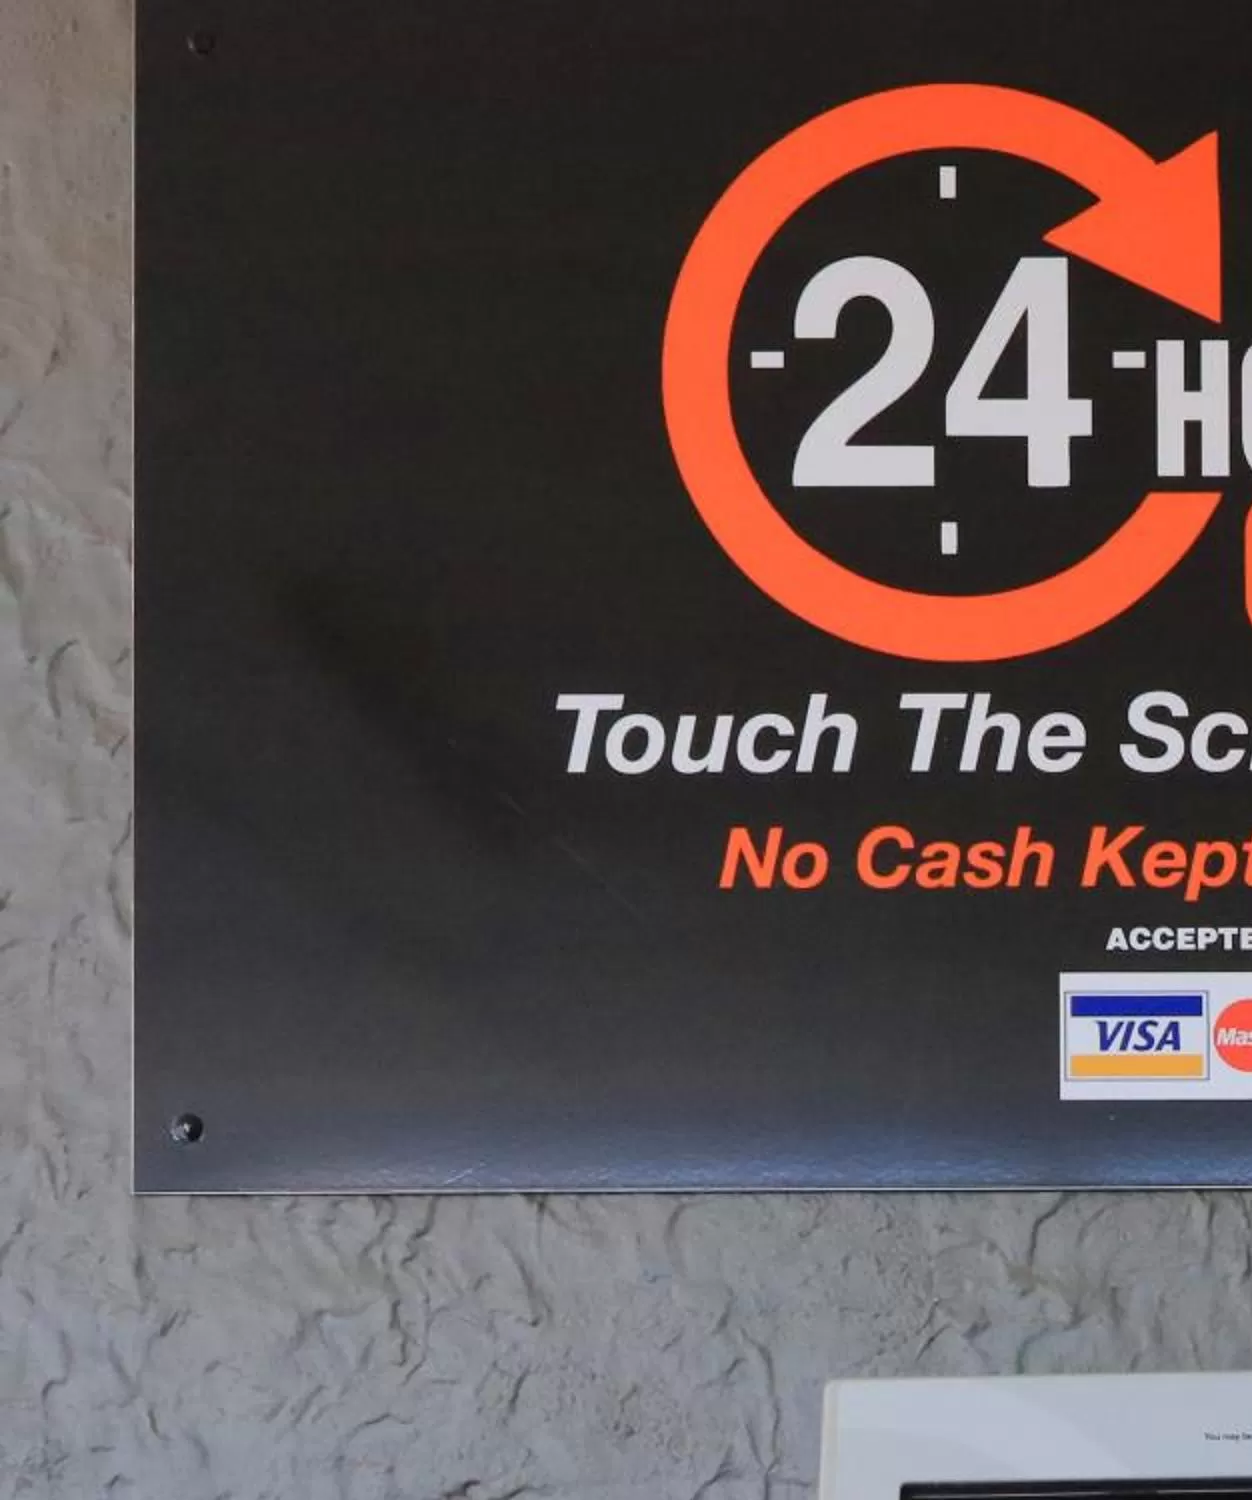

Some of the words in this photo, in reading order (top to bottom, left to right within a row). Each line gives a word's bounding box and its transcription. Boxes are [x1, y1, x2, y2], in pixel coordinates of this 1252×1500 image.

[793, 256, 1093, 488] 24
[556, 694, 858, 775] Touch
[900, 694, 1088, 774] The
[718, 825, 831, 892] No
[856, 824, 1057, 891] Cash
[1096, 1020, 1182, 1052] VISA
